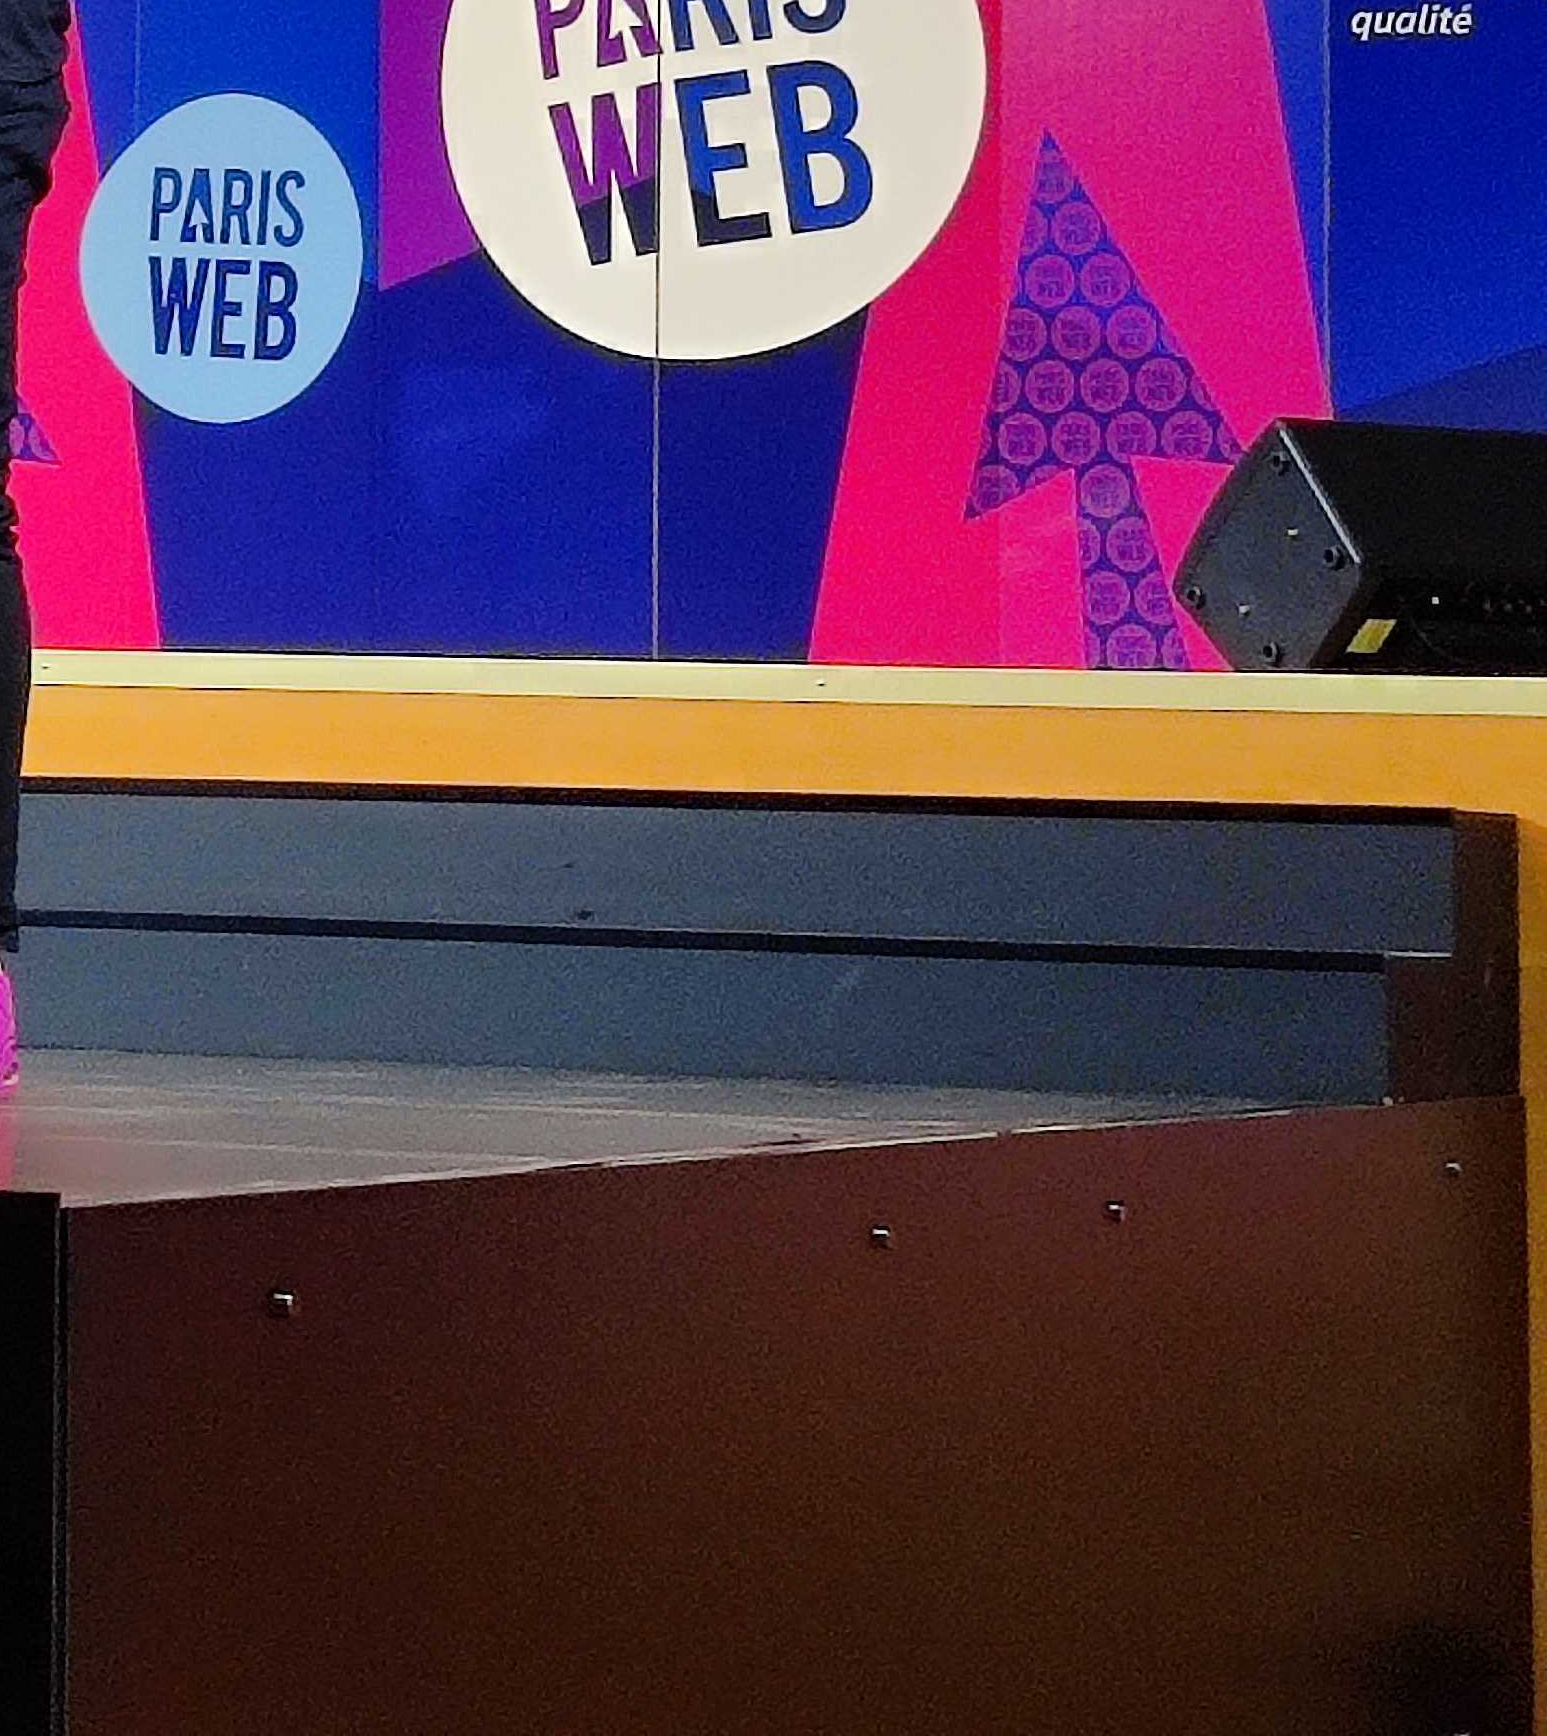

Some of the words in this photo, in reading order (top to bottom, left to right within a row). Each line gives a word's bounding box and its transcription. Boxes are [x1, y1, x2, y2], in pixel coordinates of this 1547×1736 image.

[1350, 4, 1473, 41] qualité
[150, 166, 305, 247] PARIS
[547, 60, 873, 266] WEB
[148, 255, 298, 361] WEB
